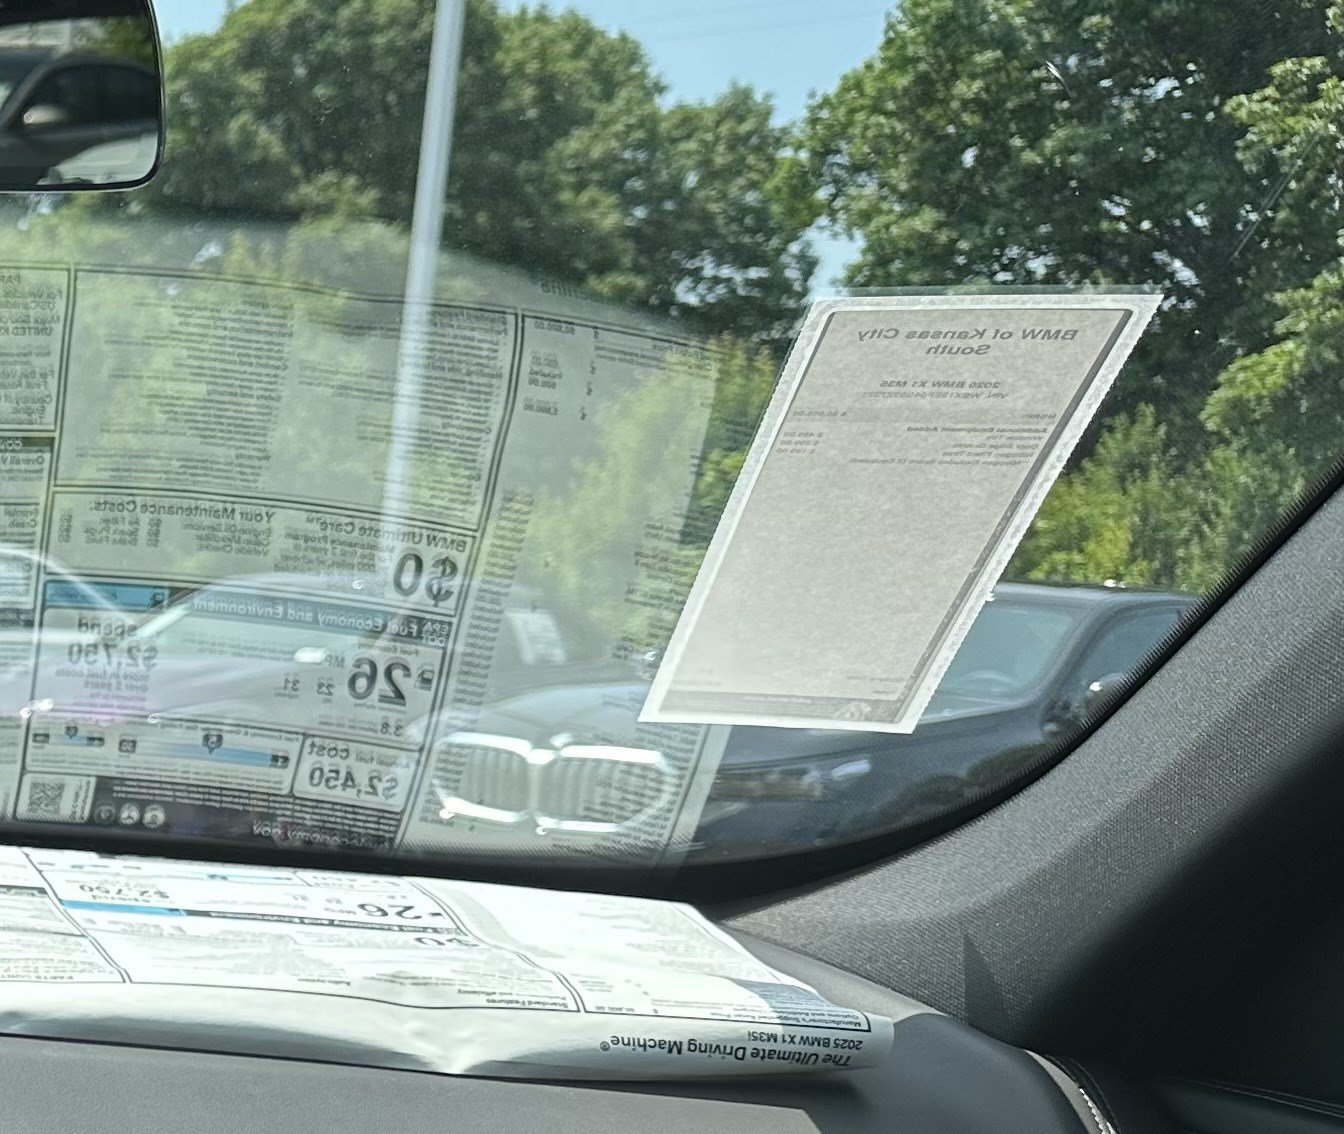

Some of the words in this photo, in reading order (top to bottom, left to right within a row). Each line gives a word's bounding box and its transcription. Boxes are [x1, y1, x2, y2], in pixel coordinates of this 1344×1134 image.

[356, 903, 423, 920] 26
[747, 1030, 779, 1043] M35i
[782, 1033, 797, 1045] X1
[798, 1035, 831, 1049] BMW
[688, 1042, 746, 1061] Driving
[833, 1038, 864, 1051] 2025
[749, 1047, 819, 1066] Ultimate
[822, 1052, 852, 1066] The
